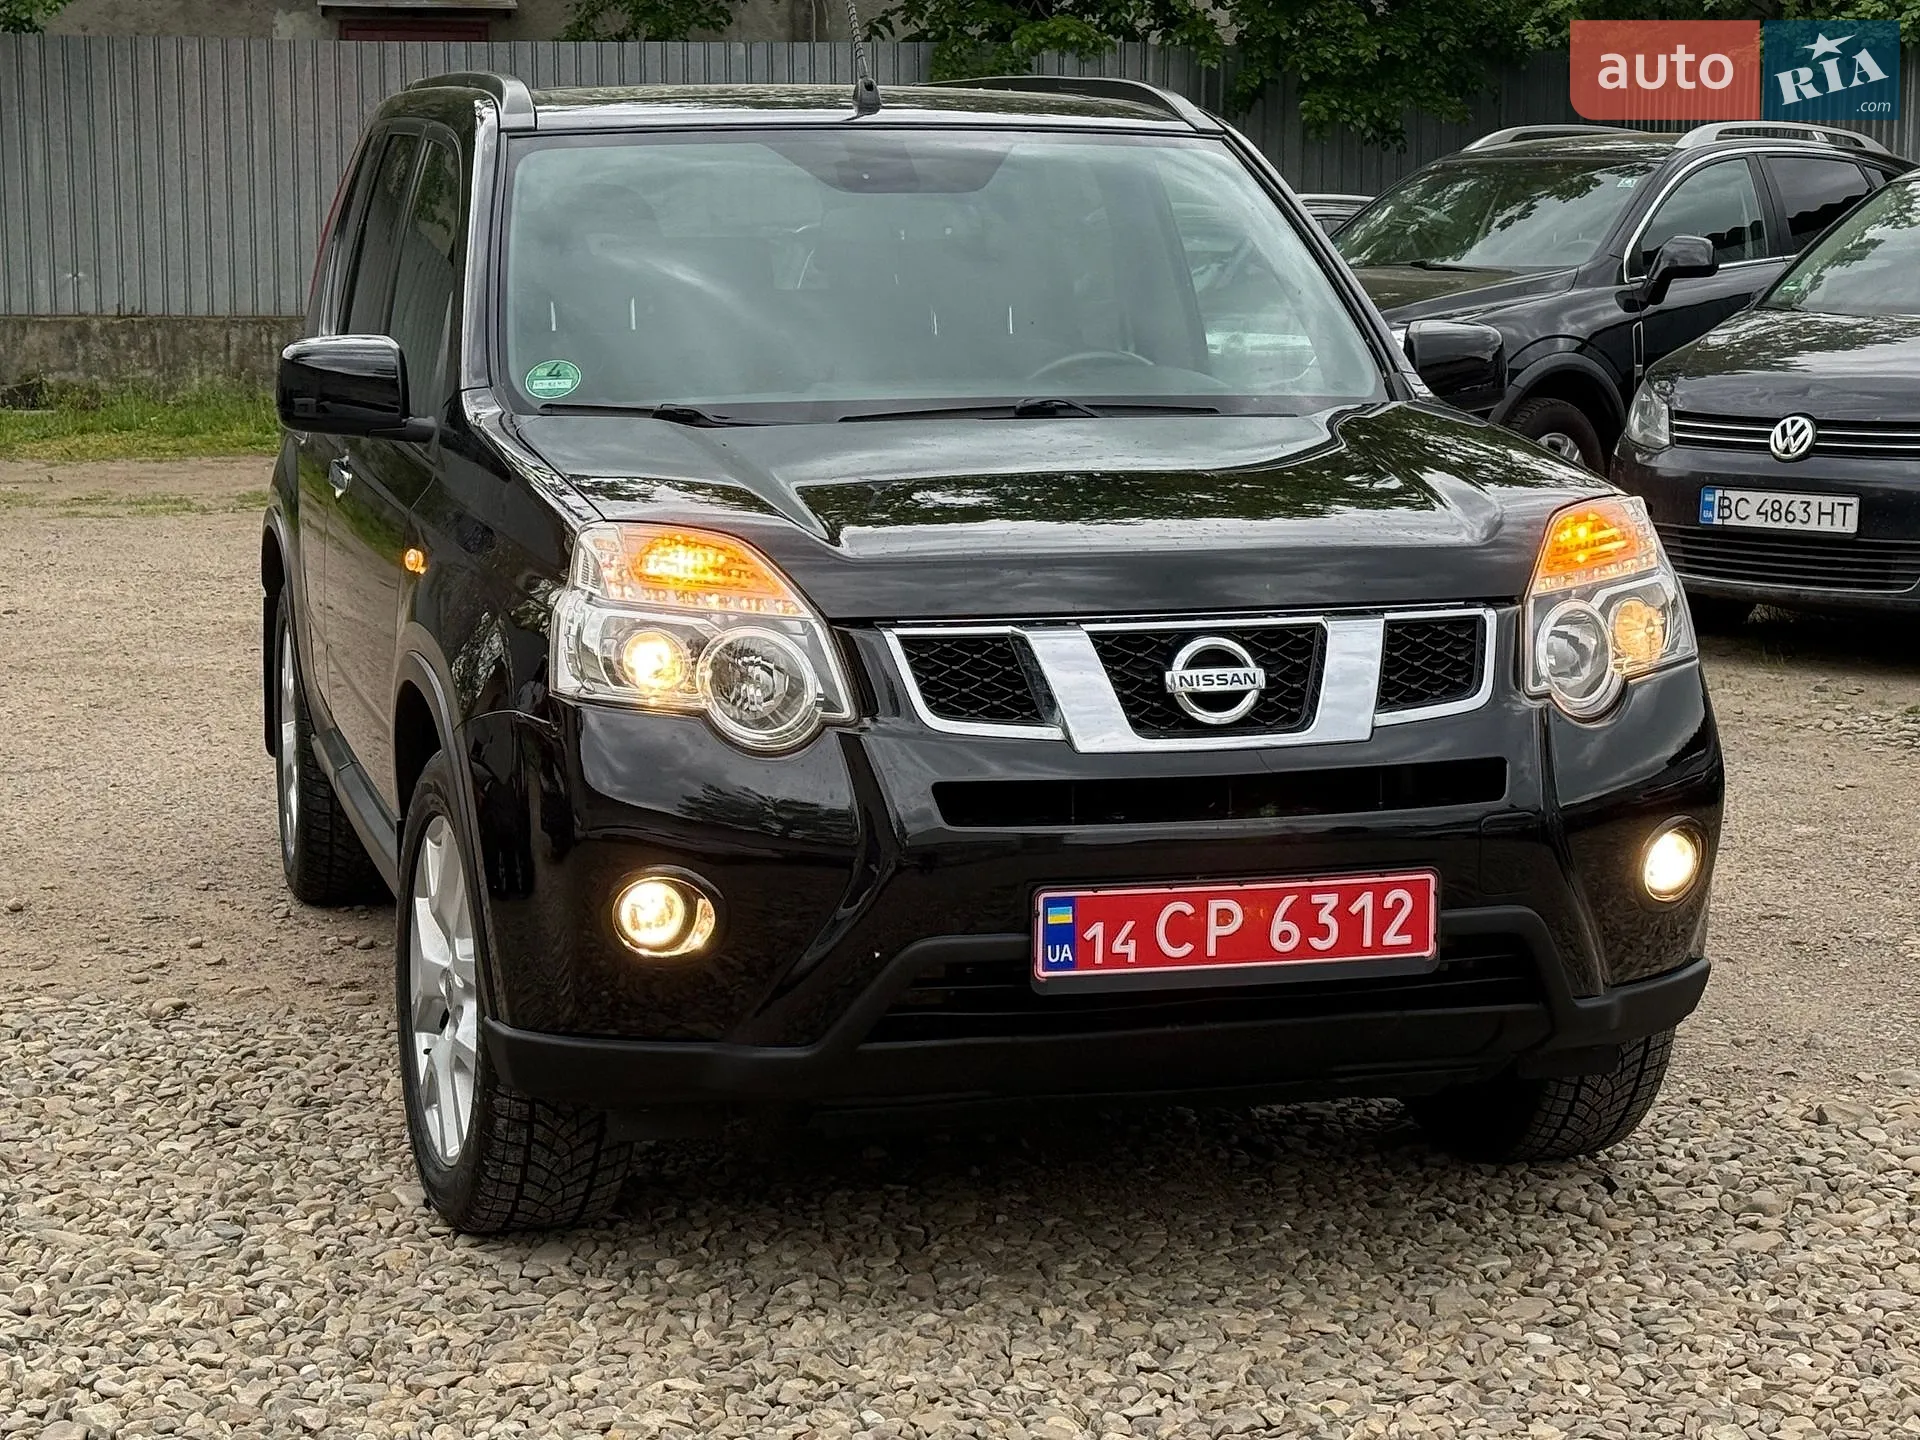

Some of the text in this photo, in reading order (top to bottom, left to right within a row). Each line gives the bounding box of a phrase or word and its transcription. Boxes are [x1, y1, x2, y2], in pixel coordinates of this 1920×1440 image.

[546, 362, 562, 377] 4
[1717, 496, 1854, 527] BC 4863 HT
[1178, 672, 1257, 688] NISSAN
[1083, 888, 1414, 965] 14 CP 6312
[1047, 944, 1073, 963] UA
